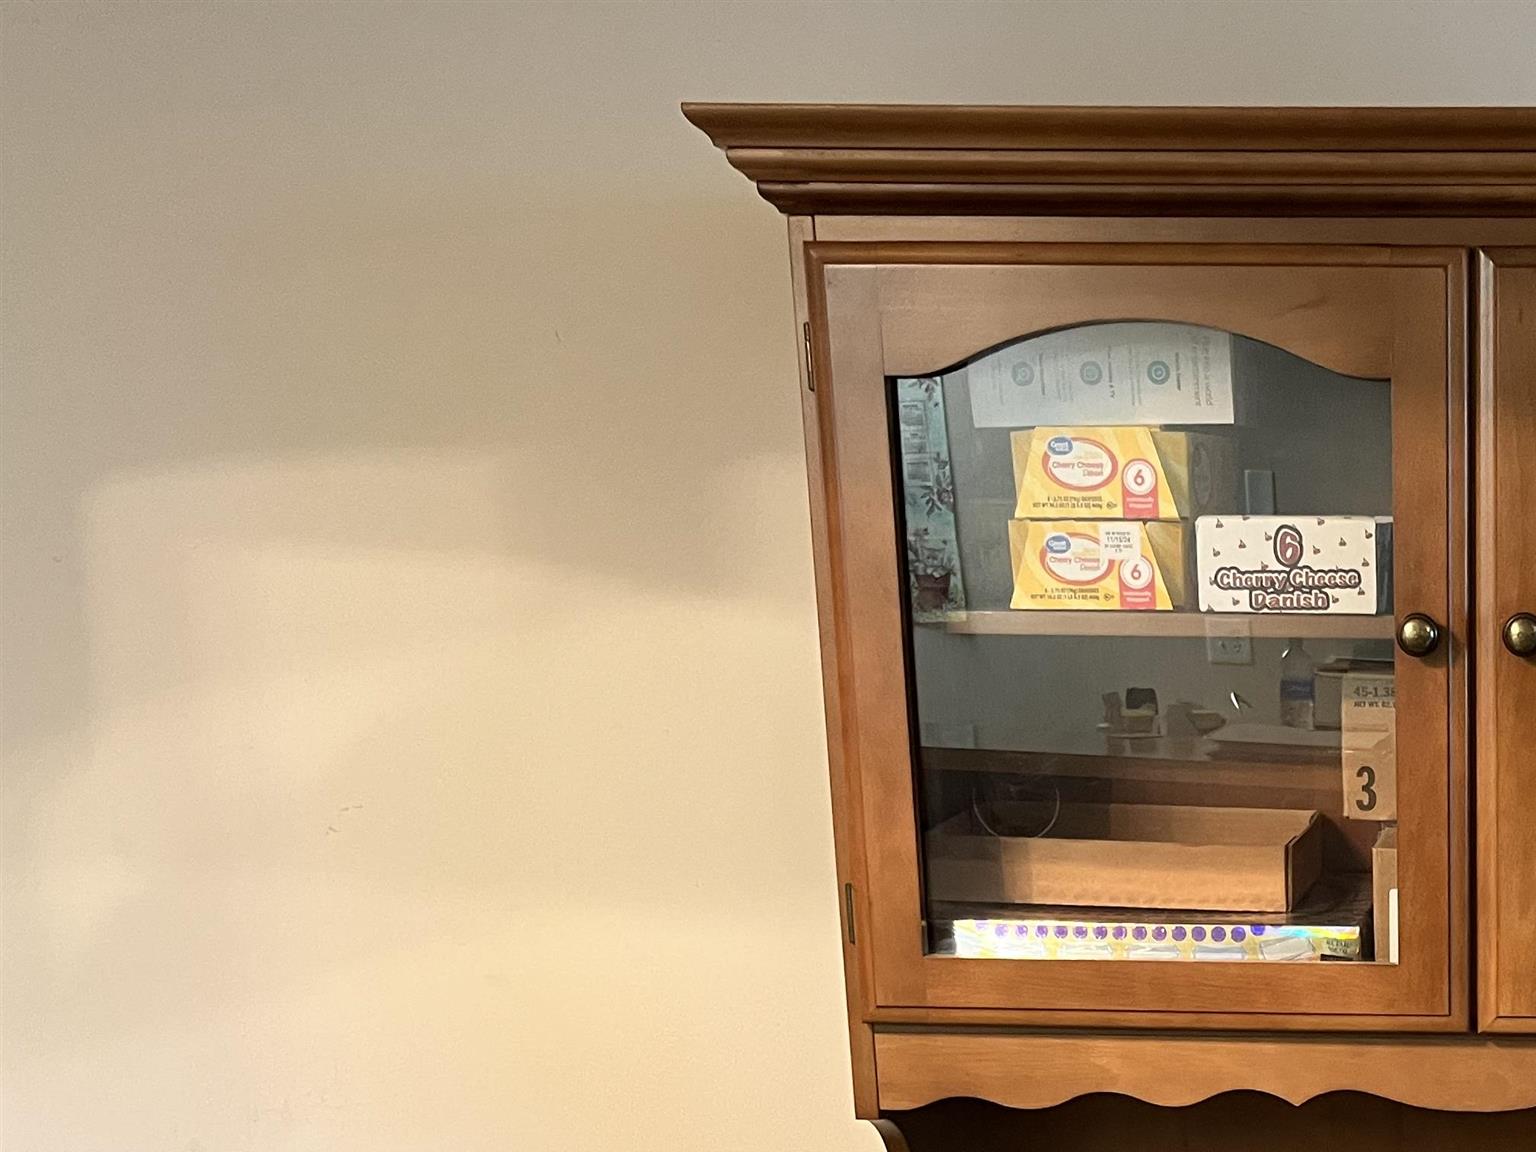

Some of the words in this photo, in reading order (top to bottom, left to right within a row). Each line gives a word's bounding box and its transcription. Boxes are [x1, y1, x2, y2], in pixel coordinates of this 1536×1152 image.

[1133, 469, 1145, 486] 6
[1275, 527, 1302, 567] 6
[1130, 563, 1142, 580] 6
[1216, 567, 1287, 590] Cherry
[1289, 566, 1359, 588] Cheese
[1252, 590, 1328, 609] Danish
[1355, 765, 1377, 812] 3
